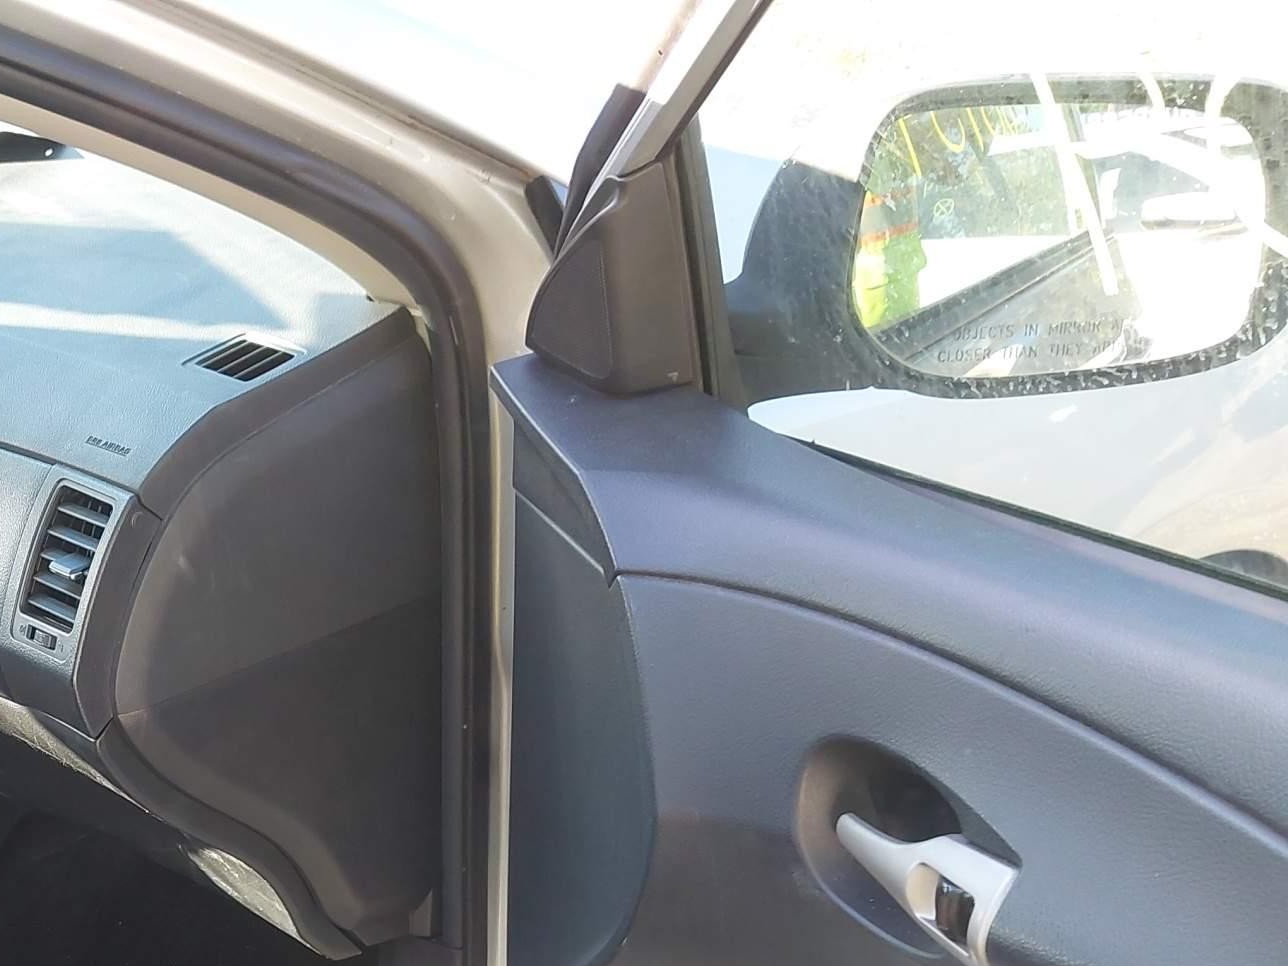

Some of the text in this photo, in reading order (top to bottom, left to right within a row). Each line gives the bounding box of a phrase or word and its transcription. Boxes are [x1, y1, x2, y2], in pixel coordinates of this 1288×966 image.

[953, 325, 1015, 341] OBJECTS
[1024, 323, 1039, 338] IN
[1048, 320, 1102, 336] MIRROR
[937, 347, 992, 363] CLOSER
[1001, 344, 1038, 360] THAN
[1049, 343, 1083, 356] THEY
